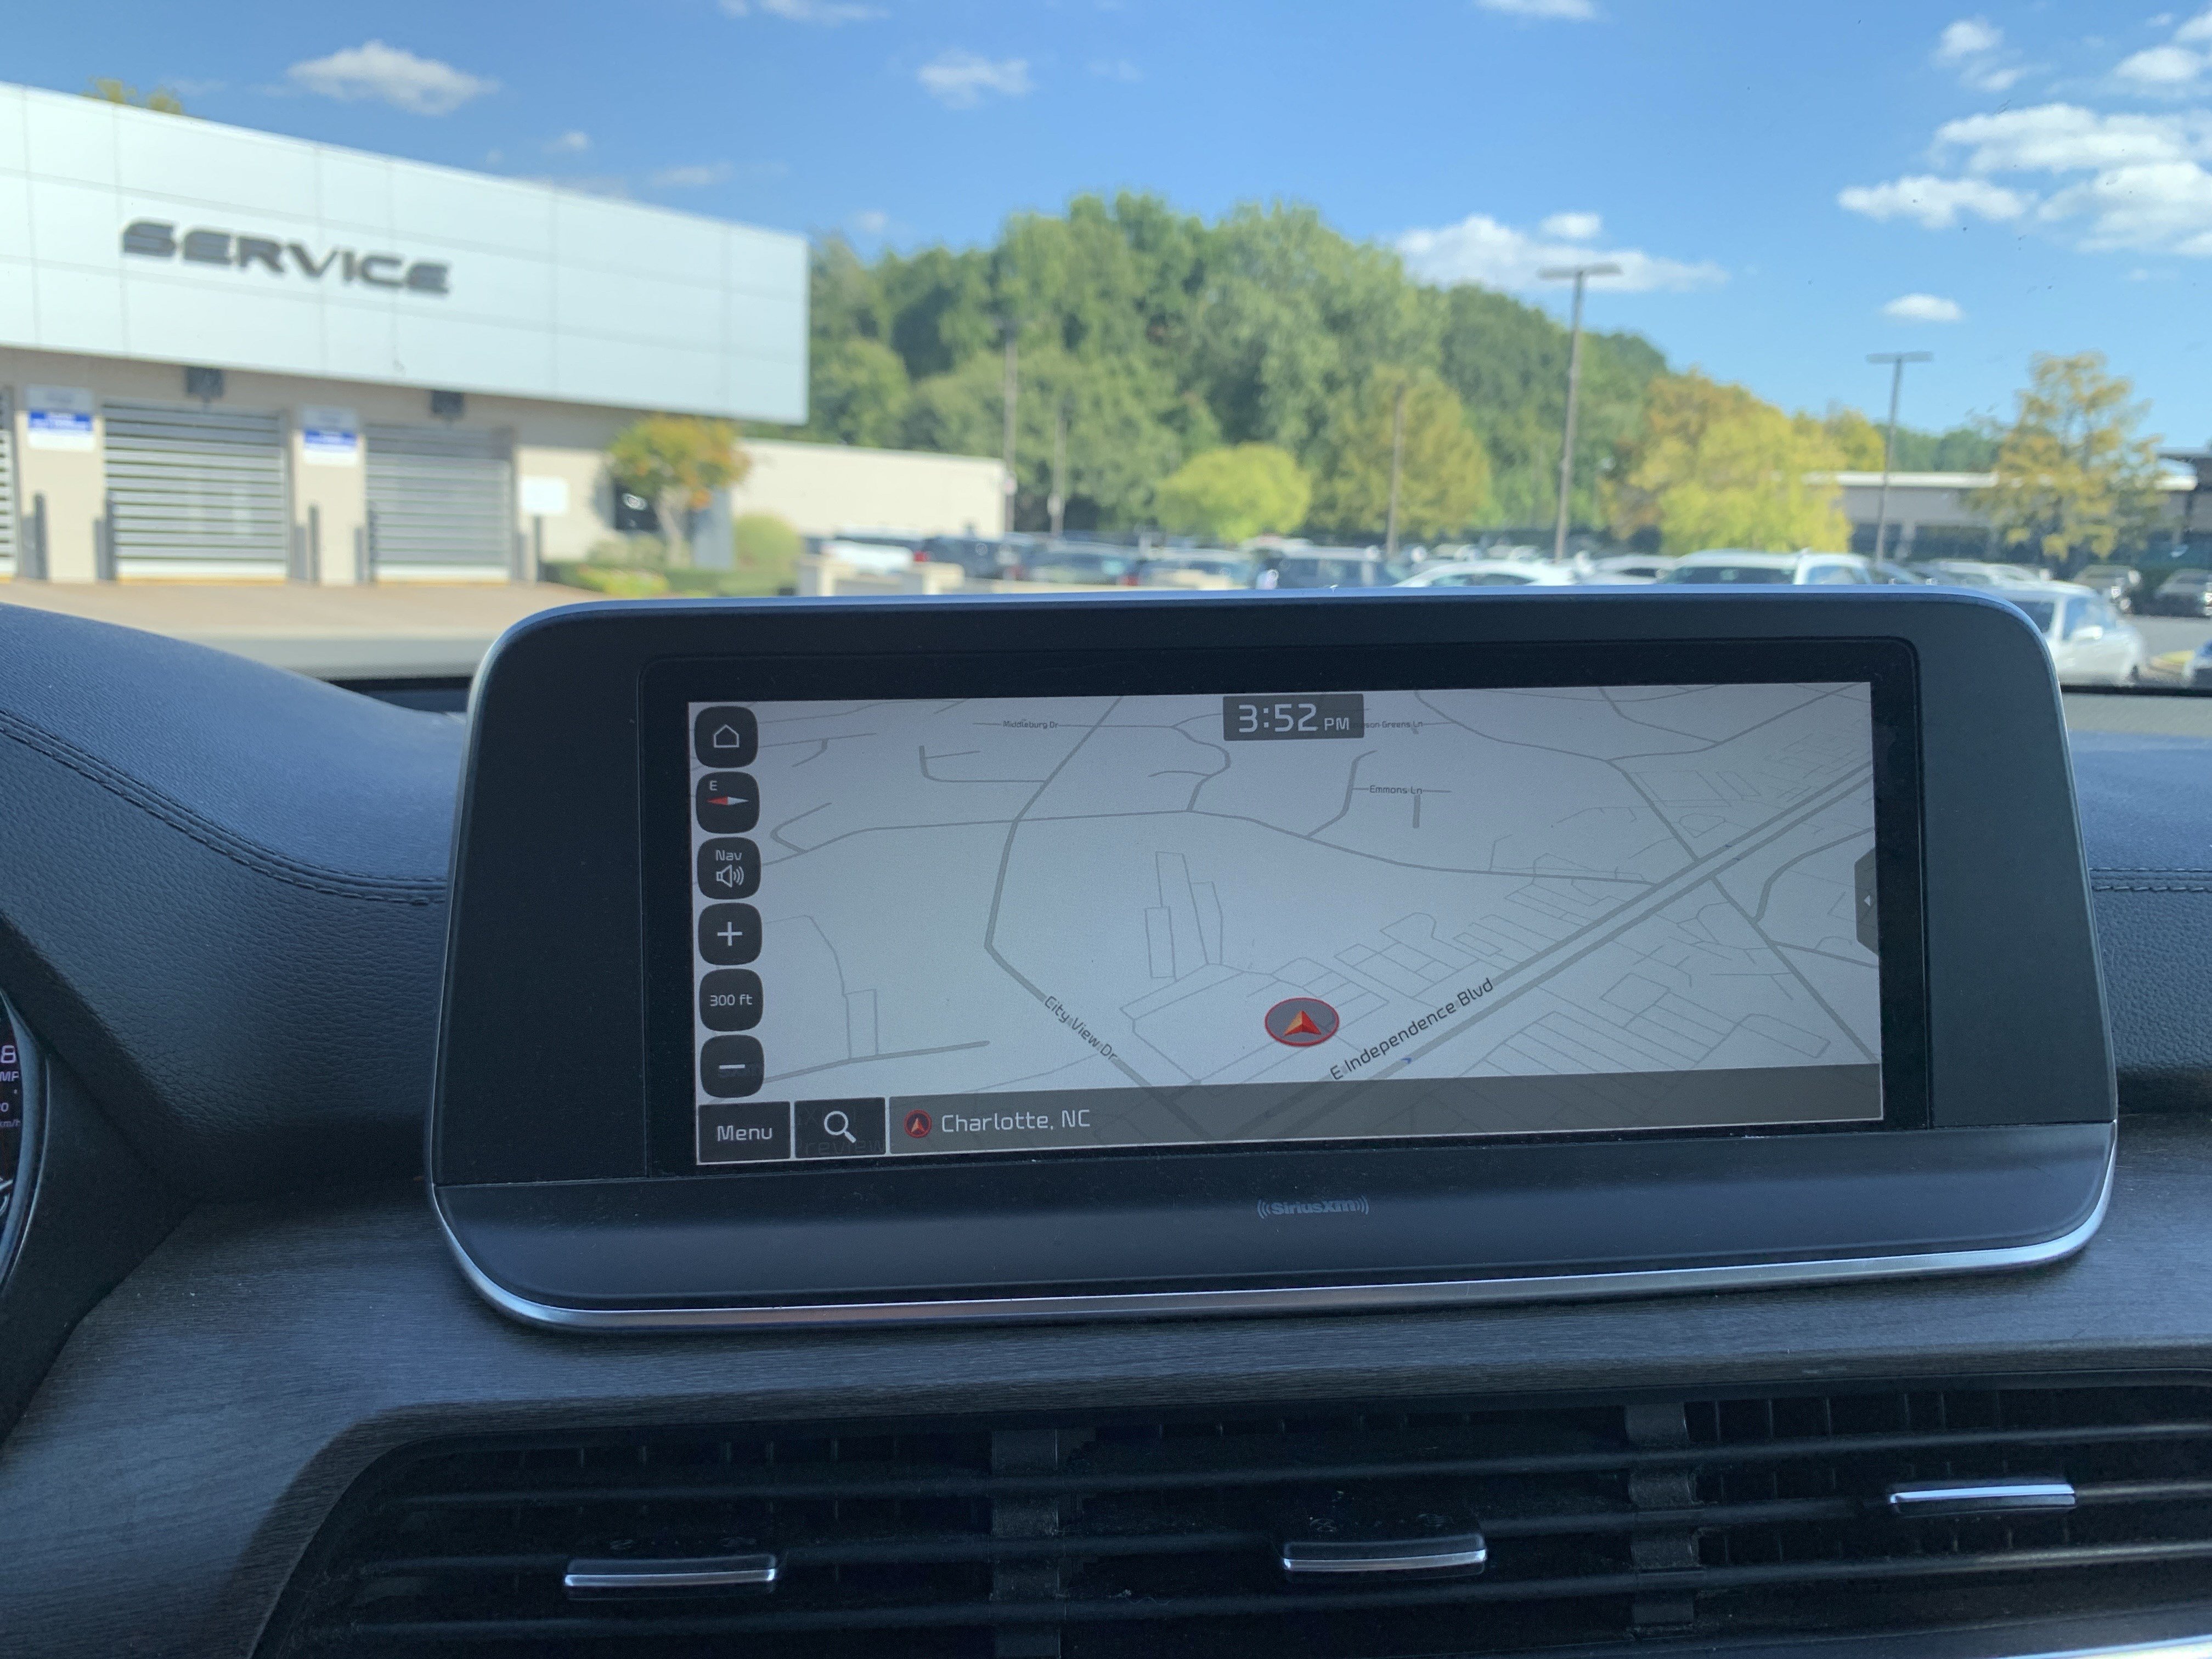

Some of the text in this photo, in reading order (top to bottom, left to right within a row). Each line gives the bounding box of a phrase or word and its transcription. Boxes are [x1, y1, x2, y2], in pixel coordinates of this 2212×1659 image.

[122, 220, 450, 295] SERVICE
[1238, 703, 1350, 732] 3:52 PM
[709, 780, 718, 791] E
[1369, 785, 1423, 794] Emmons Ln
[715, 850, 742, 861] Nav
[710, 994, 753, 1006] 300 ft
[1044, 995, 1118, 1061] City View Dr
[1330, 978, 1494, 1080] E Independence Blvd
[941, 1109, 1091, 1133] Charlotte, NC
[716, 1125, 772, 1142] Menu
